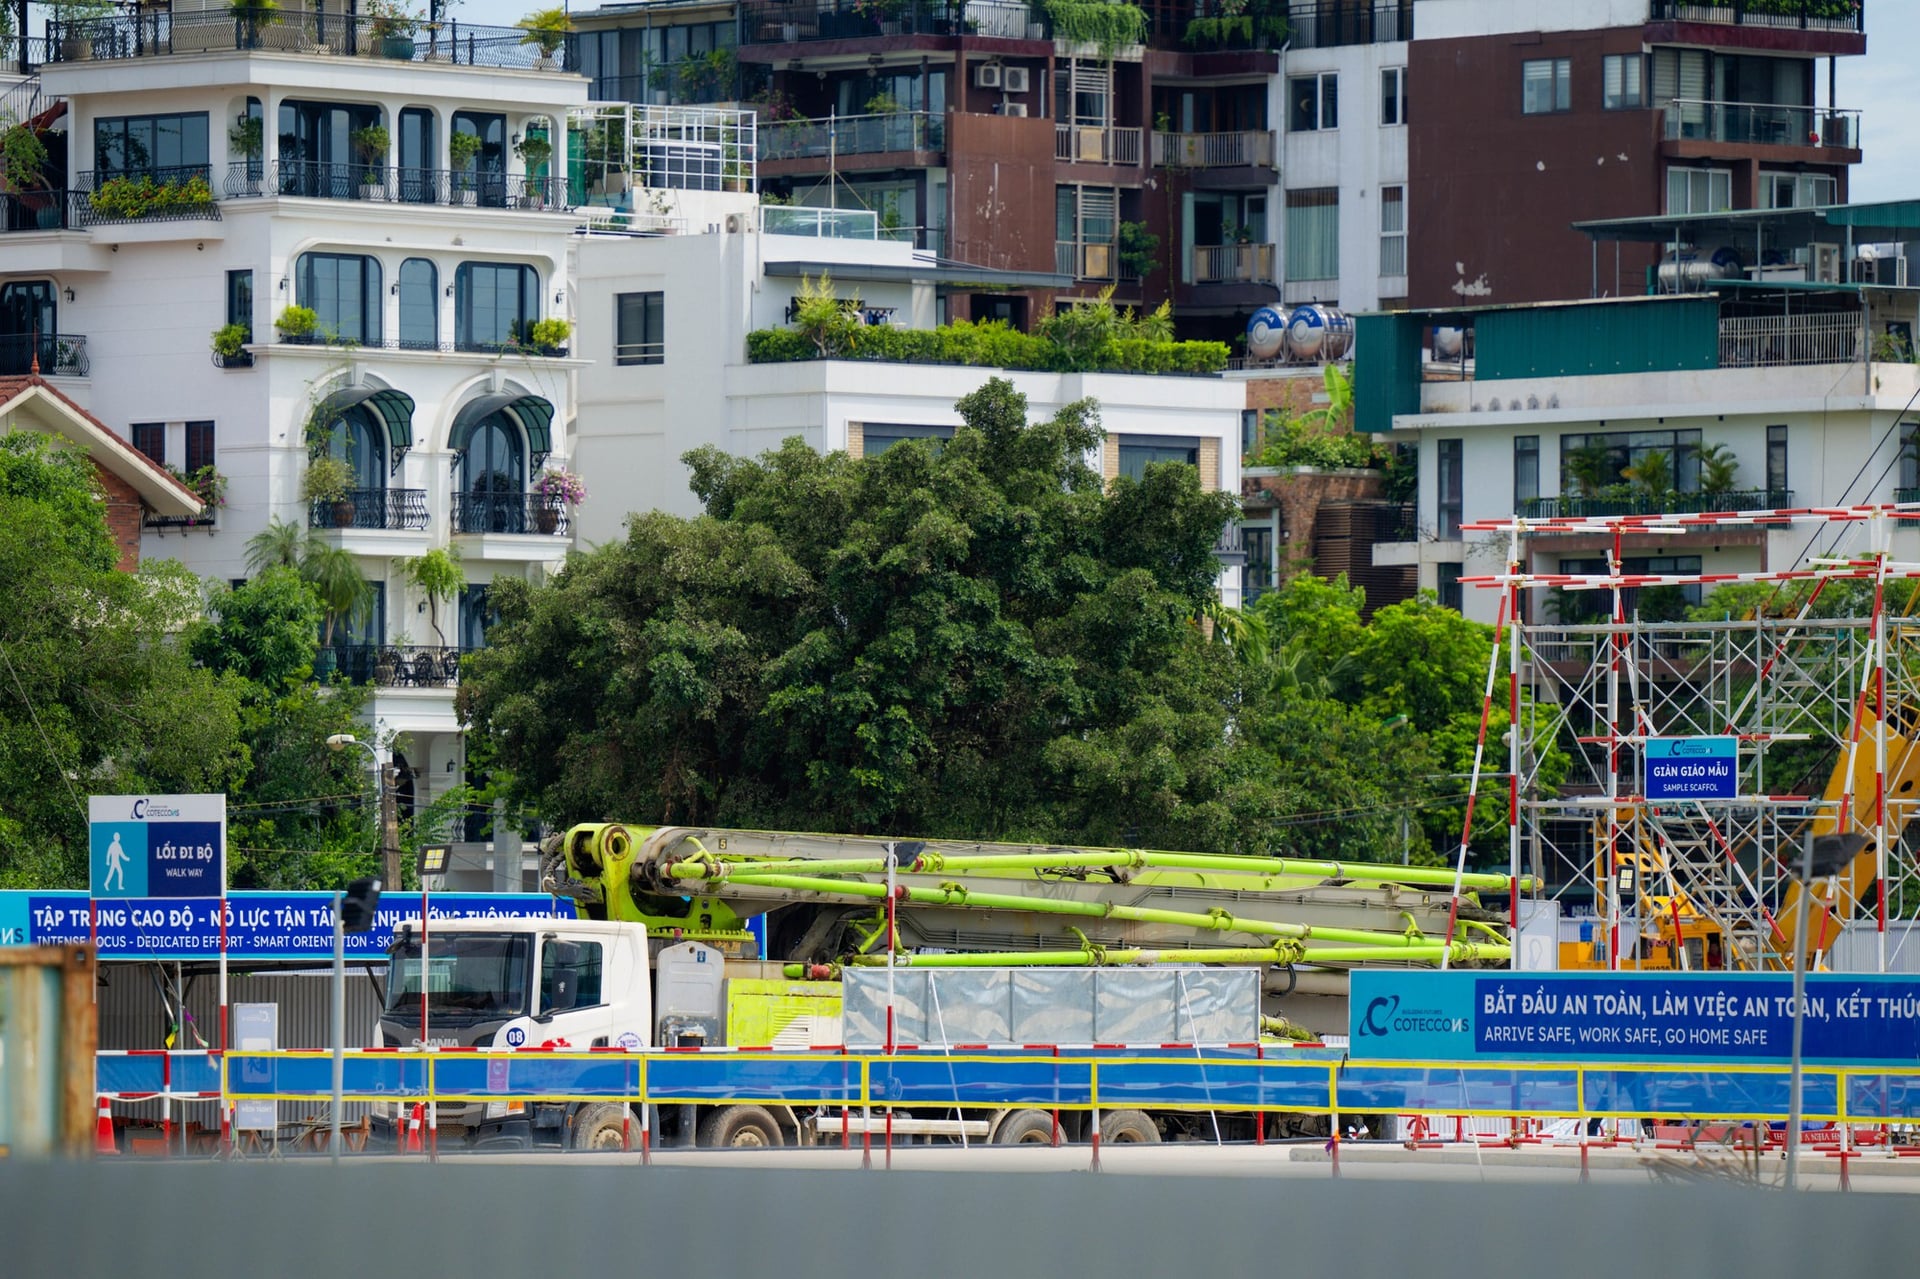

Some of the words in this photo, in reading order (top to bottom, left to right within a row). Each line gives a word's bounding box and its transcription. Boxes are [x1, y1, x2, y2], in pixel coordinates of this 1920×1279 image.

[1653, 764, 1678, 777] GIÀN
[1680, 763, 1706, 777] GIÁO
[1708, 761, 1729, 777] MẪU
[1663, 783, 1688, 792] SAMPLE
[1689, 783, 1719, 792] SCAFFOL
[156, 840, 176, 860] LỐI
[179, 846, 193, 860] ĐI
[197, 843, 213, 863] BỘ
[165, 868, 187, 878] WALK
[187, 868, 204, 878] WAY
[33, 905, 65, 931] TẬP
[131, 909, 165, 927] CAO
[169, 905, 194, 931] ĐỘ
[210, 901, 235, 927] NỖ
[239, 906, 270, 930] LỰC
[274, 905, 306, 931] TẬN
[90, 936, 127, 948] OCUS
[136, 935, 200, 948] DEDICATED
[254, 936, 290, 949] SMART
[1483, 984, 1516, 1015] BẮT
[1521, 985, 1557, 1015] ĐẦU
[1563, 994, 1588, 1015] AN
[1593, 990, 1647, 1020] TOÀN,
[1652, 990, 1688, 1016] LÀM
[1694, 991, 1739, 1022] VIỆC
[1743, 996, 1769, 1017] AN
[1836, 988, 1872, 1018] KẾT
[508, 1030, 523, 1044] 08
[1484, 1026, 1535, 1042] ARRIVE
[1538, 1026, 1576, 1045] SAFE,
[1578, 1027, 1620, 1044] WORK
[1624, 1027, 1662, 1047] SAFE,
[1665, 1028, 1686, 1045] GO
[1690, 1028, 1731, 1045] HOME
[1733, 1028, 1768, 1046] SAFE
